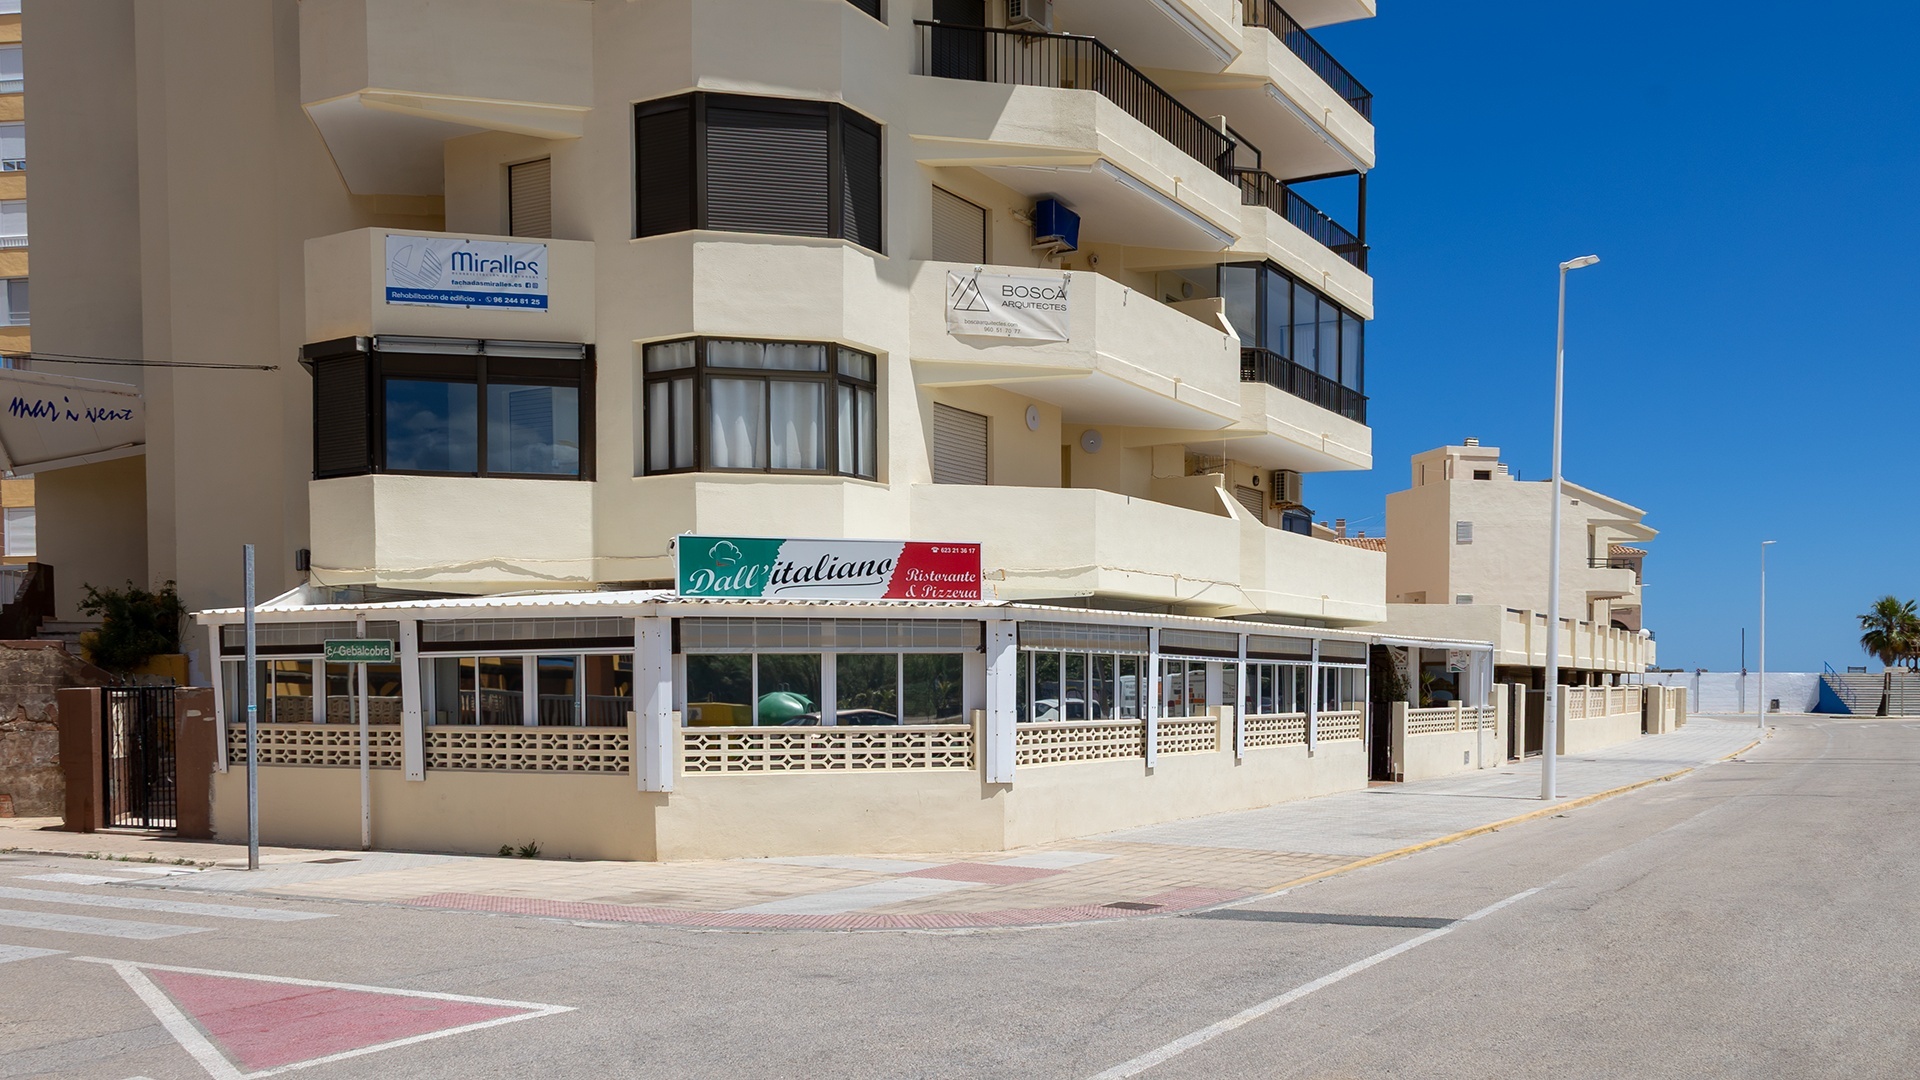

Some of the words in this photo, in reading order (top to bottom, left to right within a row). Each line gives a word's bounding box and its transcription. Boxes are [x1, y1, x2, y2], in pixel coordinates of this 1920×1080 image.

[451, 279, 523, 288] fachadasmiralles.es
[391, 291, 439, 300] Rehabilitación
[450, 294, 476, 302] edificios
[1001, 300, 1067, 311] ARQUITECTES
[8, 396, 60, 422] mar
[85, 407, 134, 423] vent
[905, 567, 976, 583] Ristorante
[905, 584, 917, 598] &
[921, 584, 978, 598] Pizzeria
